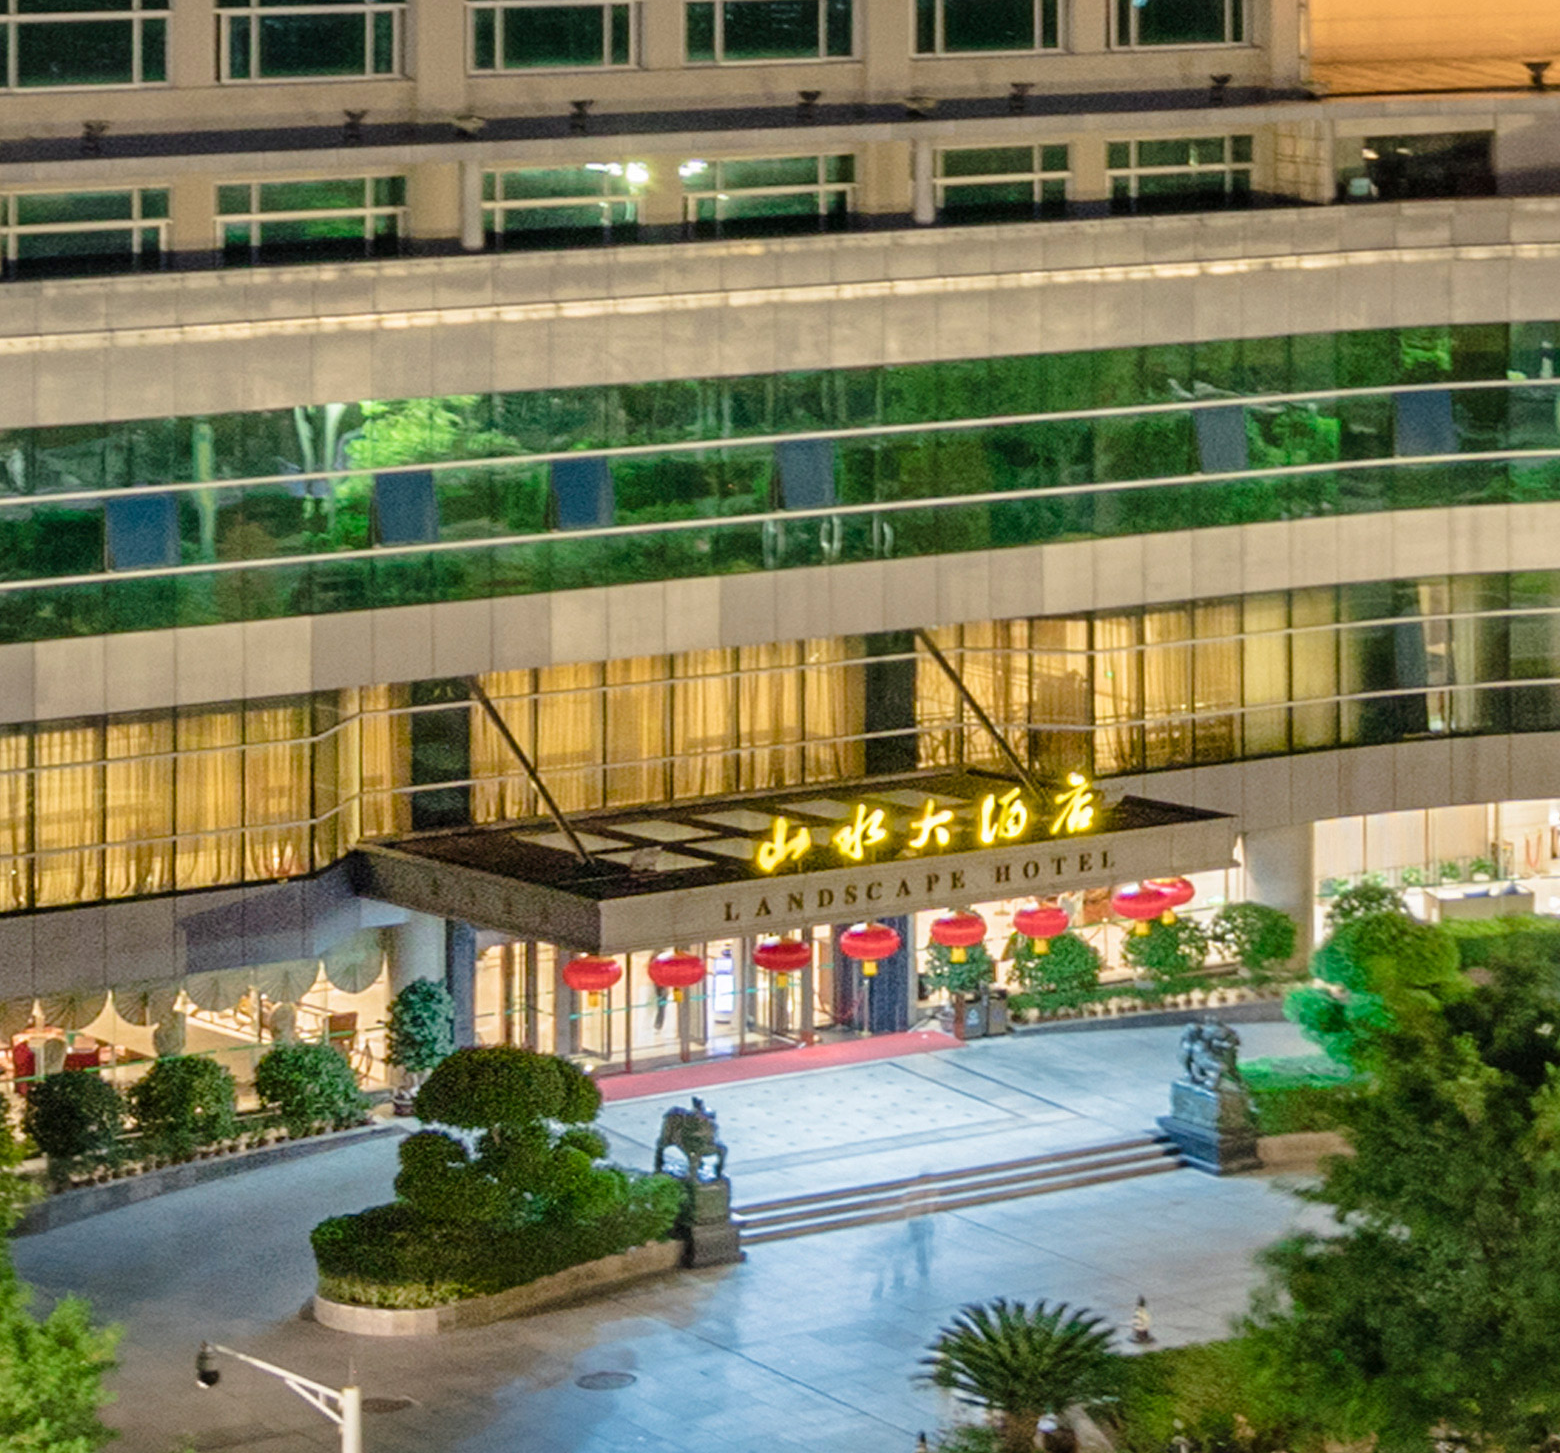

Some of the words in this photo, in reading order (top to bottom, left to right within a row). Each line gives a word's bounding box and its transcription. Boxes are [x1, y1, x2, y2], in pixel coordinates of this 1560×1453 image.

[756, 772, 1096, 873] 山水大酒店
[723, 869, 966, 922] LANDSCAPE
[995, 849, 1117, 885] HOTEL
